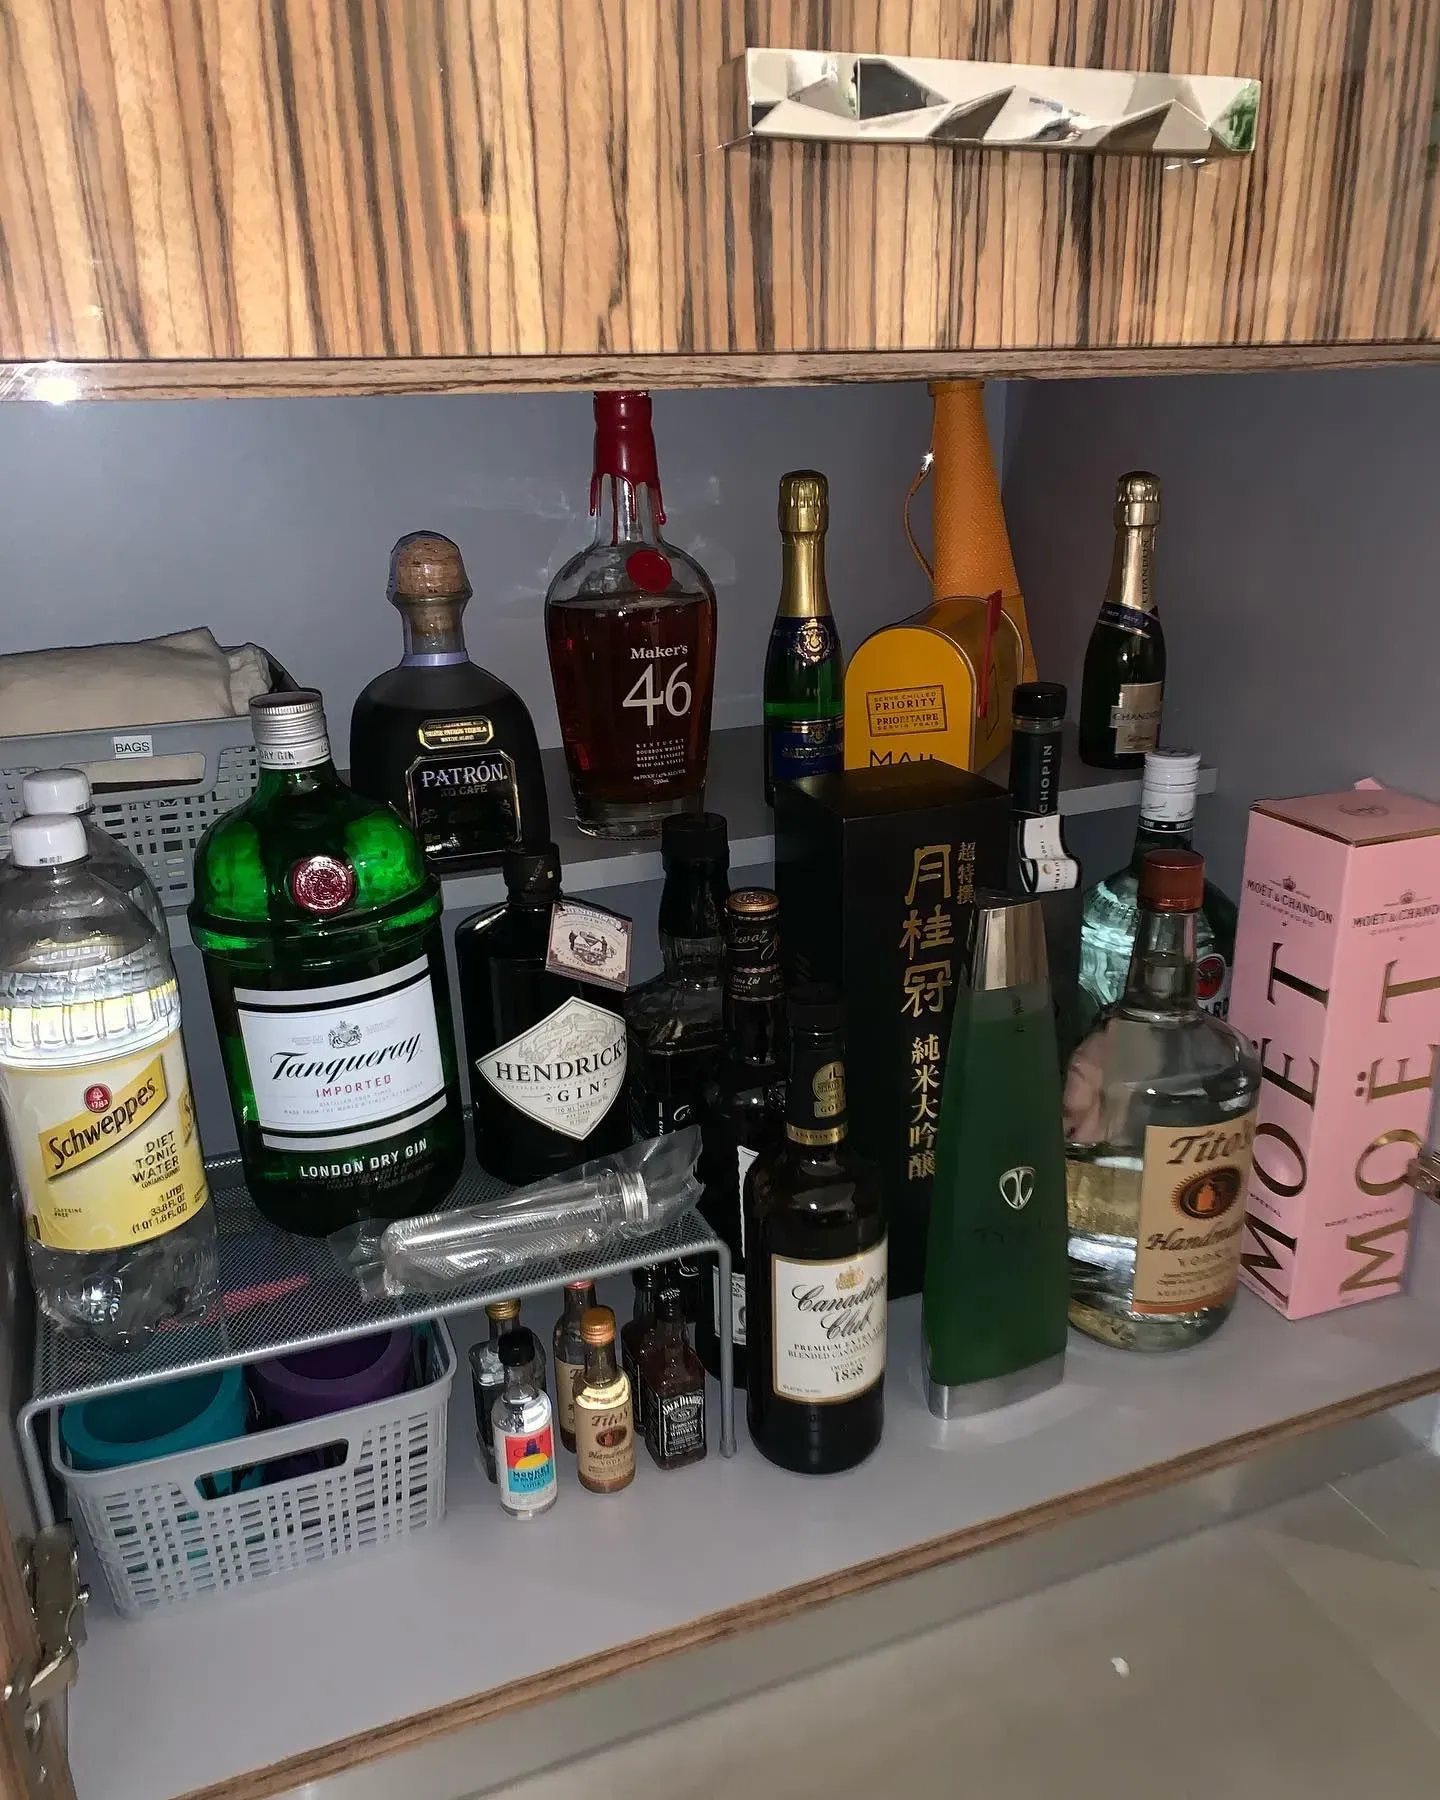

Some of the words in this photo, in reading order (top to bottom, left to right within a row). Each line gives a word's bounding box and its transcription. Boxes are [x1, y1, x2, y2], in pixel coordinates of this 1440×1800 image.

[630, 644, 688, 660] Maker's
[622, 662, 692, 726] 46
[875, 697, 936, 711] PRIORITY
[901, 691, 937, 700] CHILLED
[876, 713, 939, 725] PRIORITAIRE
[115, 741, 150, 753] BAGS
[277, 750, 295, 760] GIN
[421, 760, 503, 788] PATRÓN
[1039, 744, 1053, 814] CHOPIN
[1281, 894, 1333, 924] CHANDON
[900, 844, 954, 1018] 月桂冠
[269, 1033, 422, 1085] Tanqueray
[316, 1074, 392, 1098] IMPORTED
[557, 1081, 600, 1102] GIN
[908, 1033, 941, 1181] 純米大吟醸
[48, 1077, 156, 1170] Schweppes
[146, 1131, 175, 1153] DIET
[135, 1143, 177, 1169] TONIC
[300, 1160, 364, 1178] LONDON
[370, 1150, 399, 1170] DRY
[404, 1138, 427, 1159] GIN
[132, 1155, 180, 1183] WATER
[165, 1184, 185, 1200] LITER
[791, 1274, 887, 1313] Canadian
[819, 1300, 874, 1340] Club
[787, 1350, 830, 1361] BLENDED
[793, 1343, 842, 1352] PREMIUM
[834, 1362, 864, 1383] 1858
